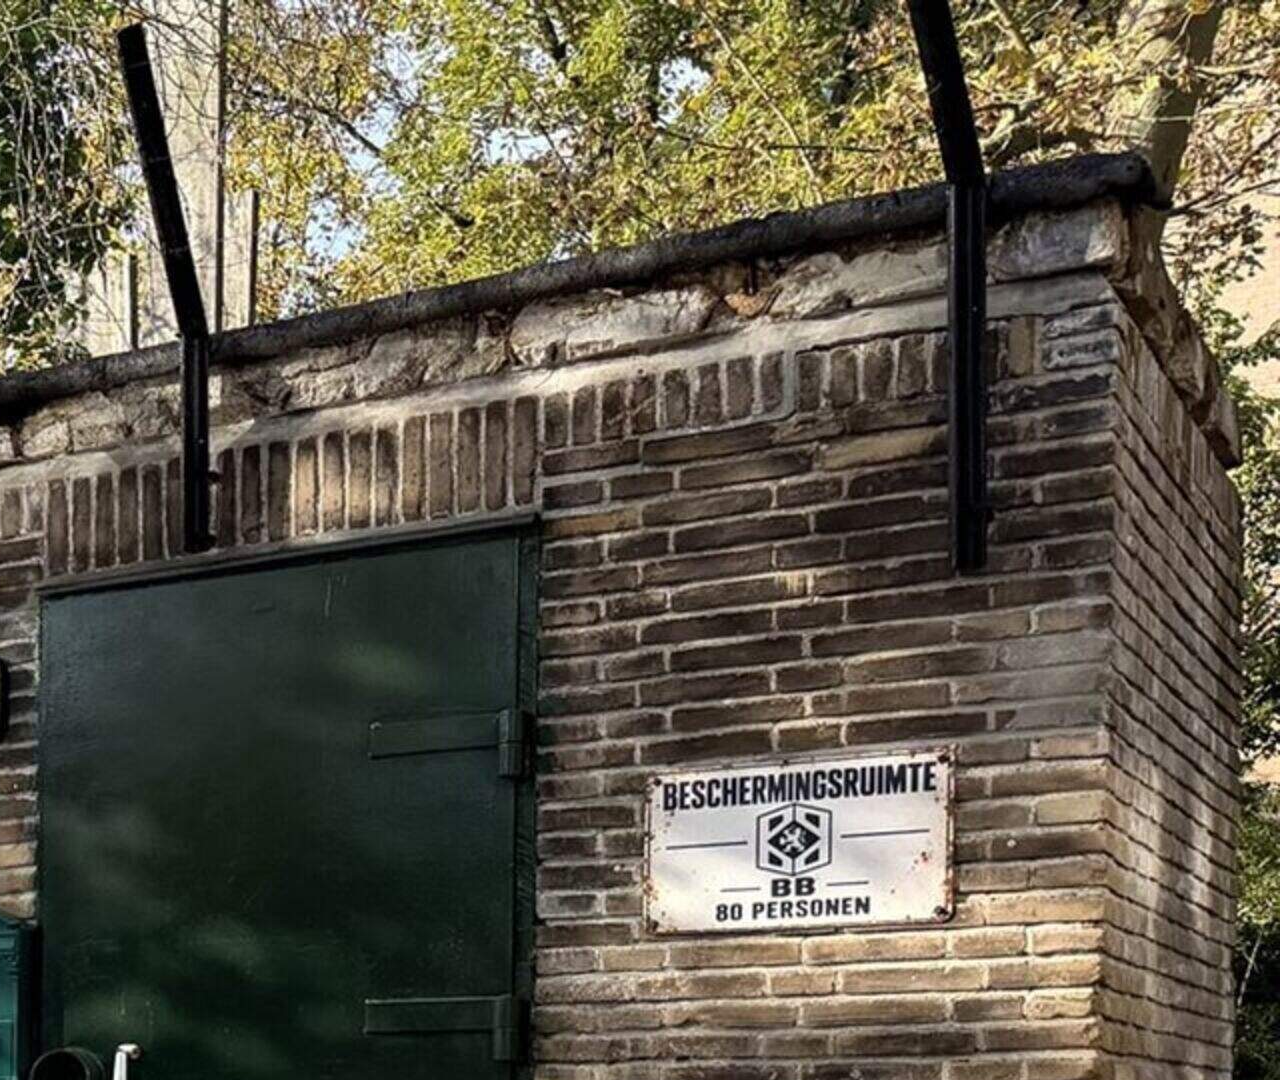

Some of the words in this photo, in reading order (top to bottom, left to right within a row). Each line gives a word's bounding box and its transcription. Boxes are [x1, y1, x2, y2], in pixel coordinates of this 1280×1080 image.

[663, 762, 937, 811] BESCHERMINGSRUIMTE
[771, 877, 815, 897] BB
[715, 902, 741, 921] 80
[752, 897, 871, 919] PERSONEN
